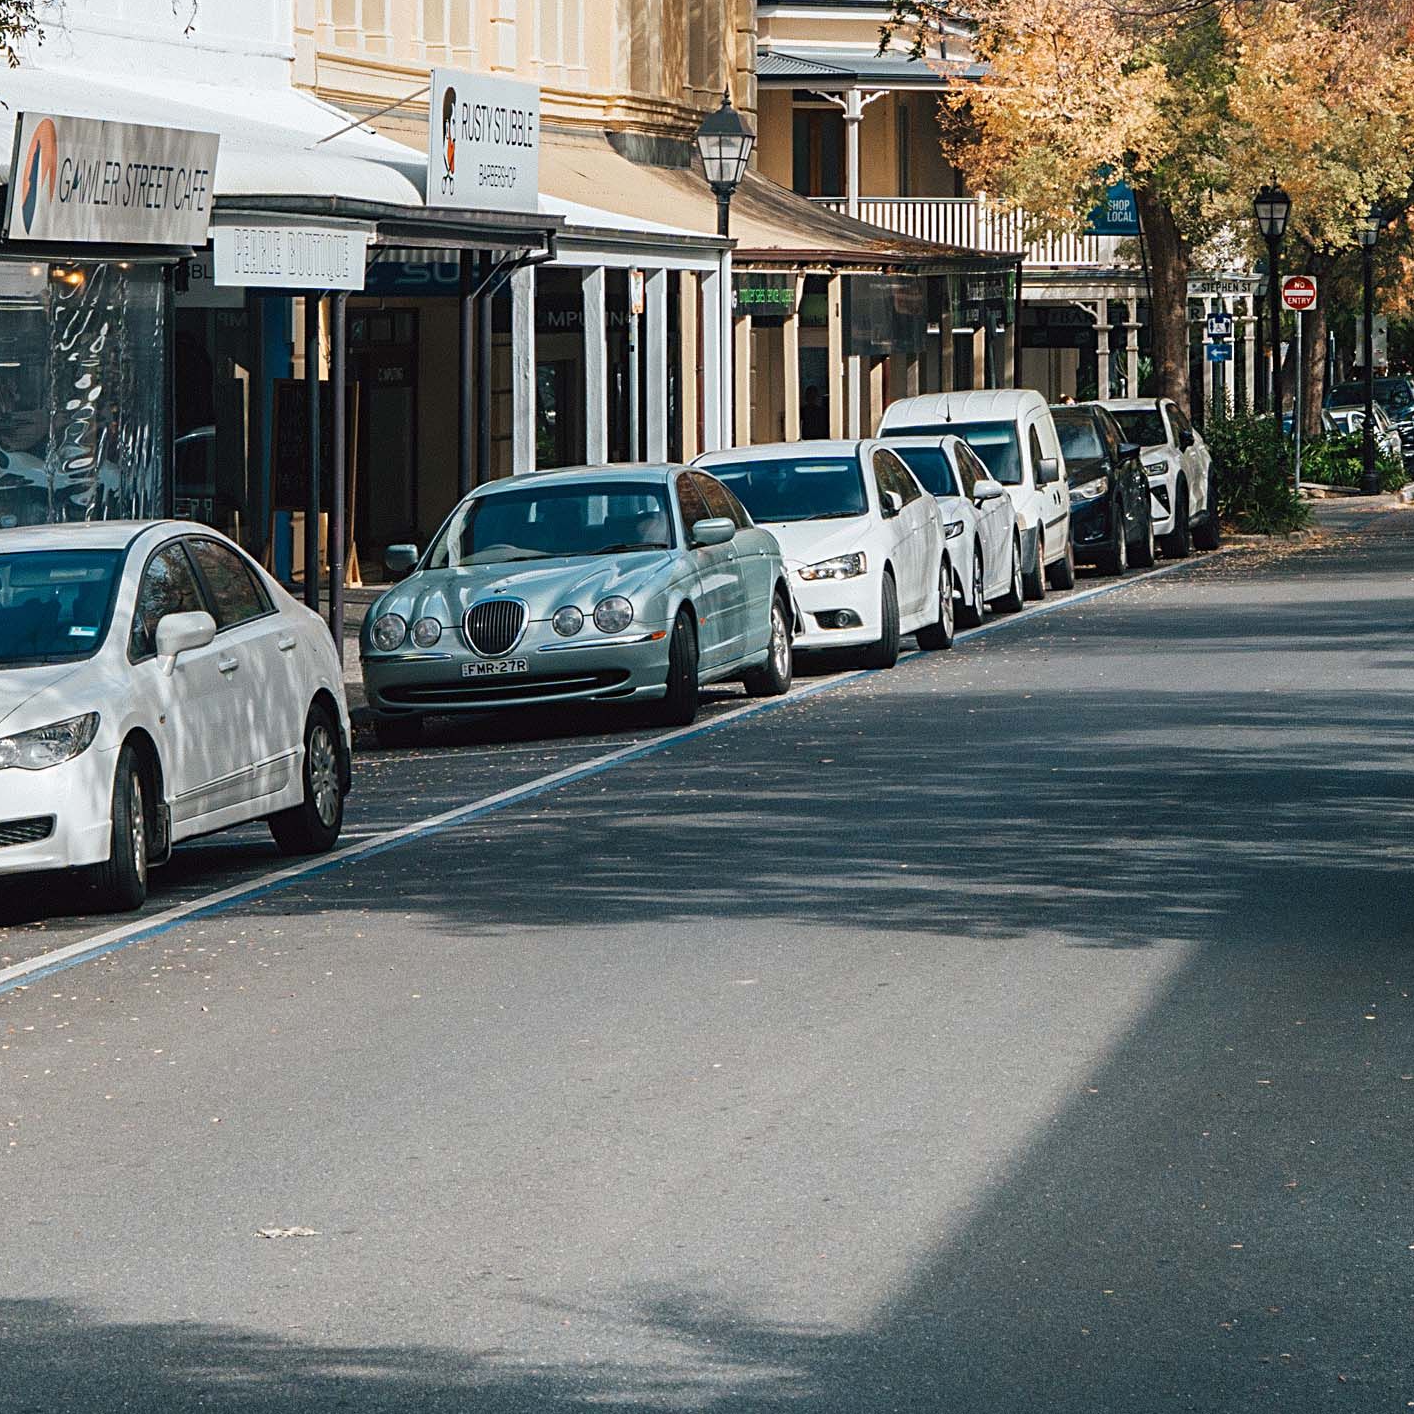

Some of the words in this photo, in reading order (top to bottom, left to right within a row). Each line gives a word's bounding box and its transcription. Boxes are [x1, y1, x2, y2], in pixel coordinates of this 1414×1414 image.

[461, 102, 493, 143] RUSTY
[494, 106, 533, 148] STUBBLE
[58, 157, 121, 206] GAWLER
[122, 162, 174, 209] STREET
[173, 167, 209, 212] CAFE
[478, 163, 517, 189] BARBERSHOP
[1107, 199, 1130, 211] SHOP
[288, 231, 350, 282] BOUTIQUE
[1201, 281, 1239, 293] STEPHEN
[1241, 282, 1251, 292] ST
[1294, 281, 1306, 289] NO
[1287, 297, 1312, 305] ENTRY
